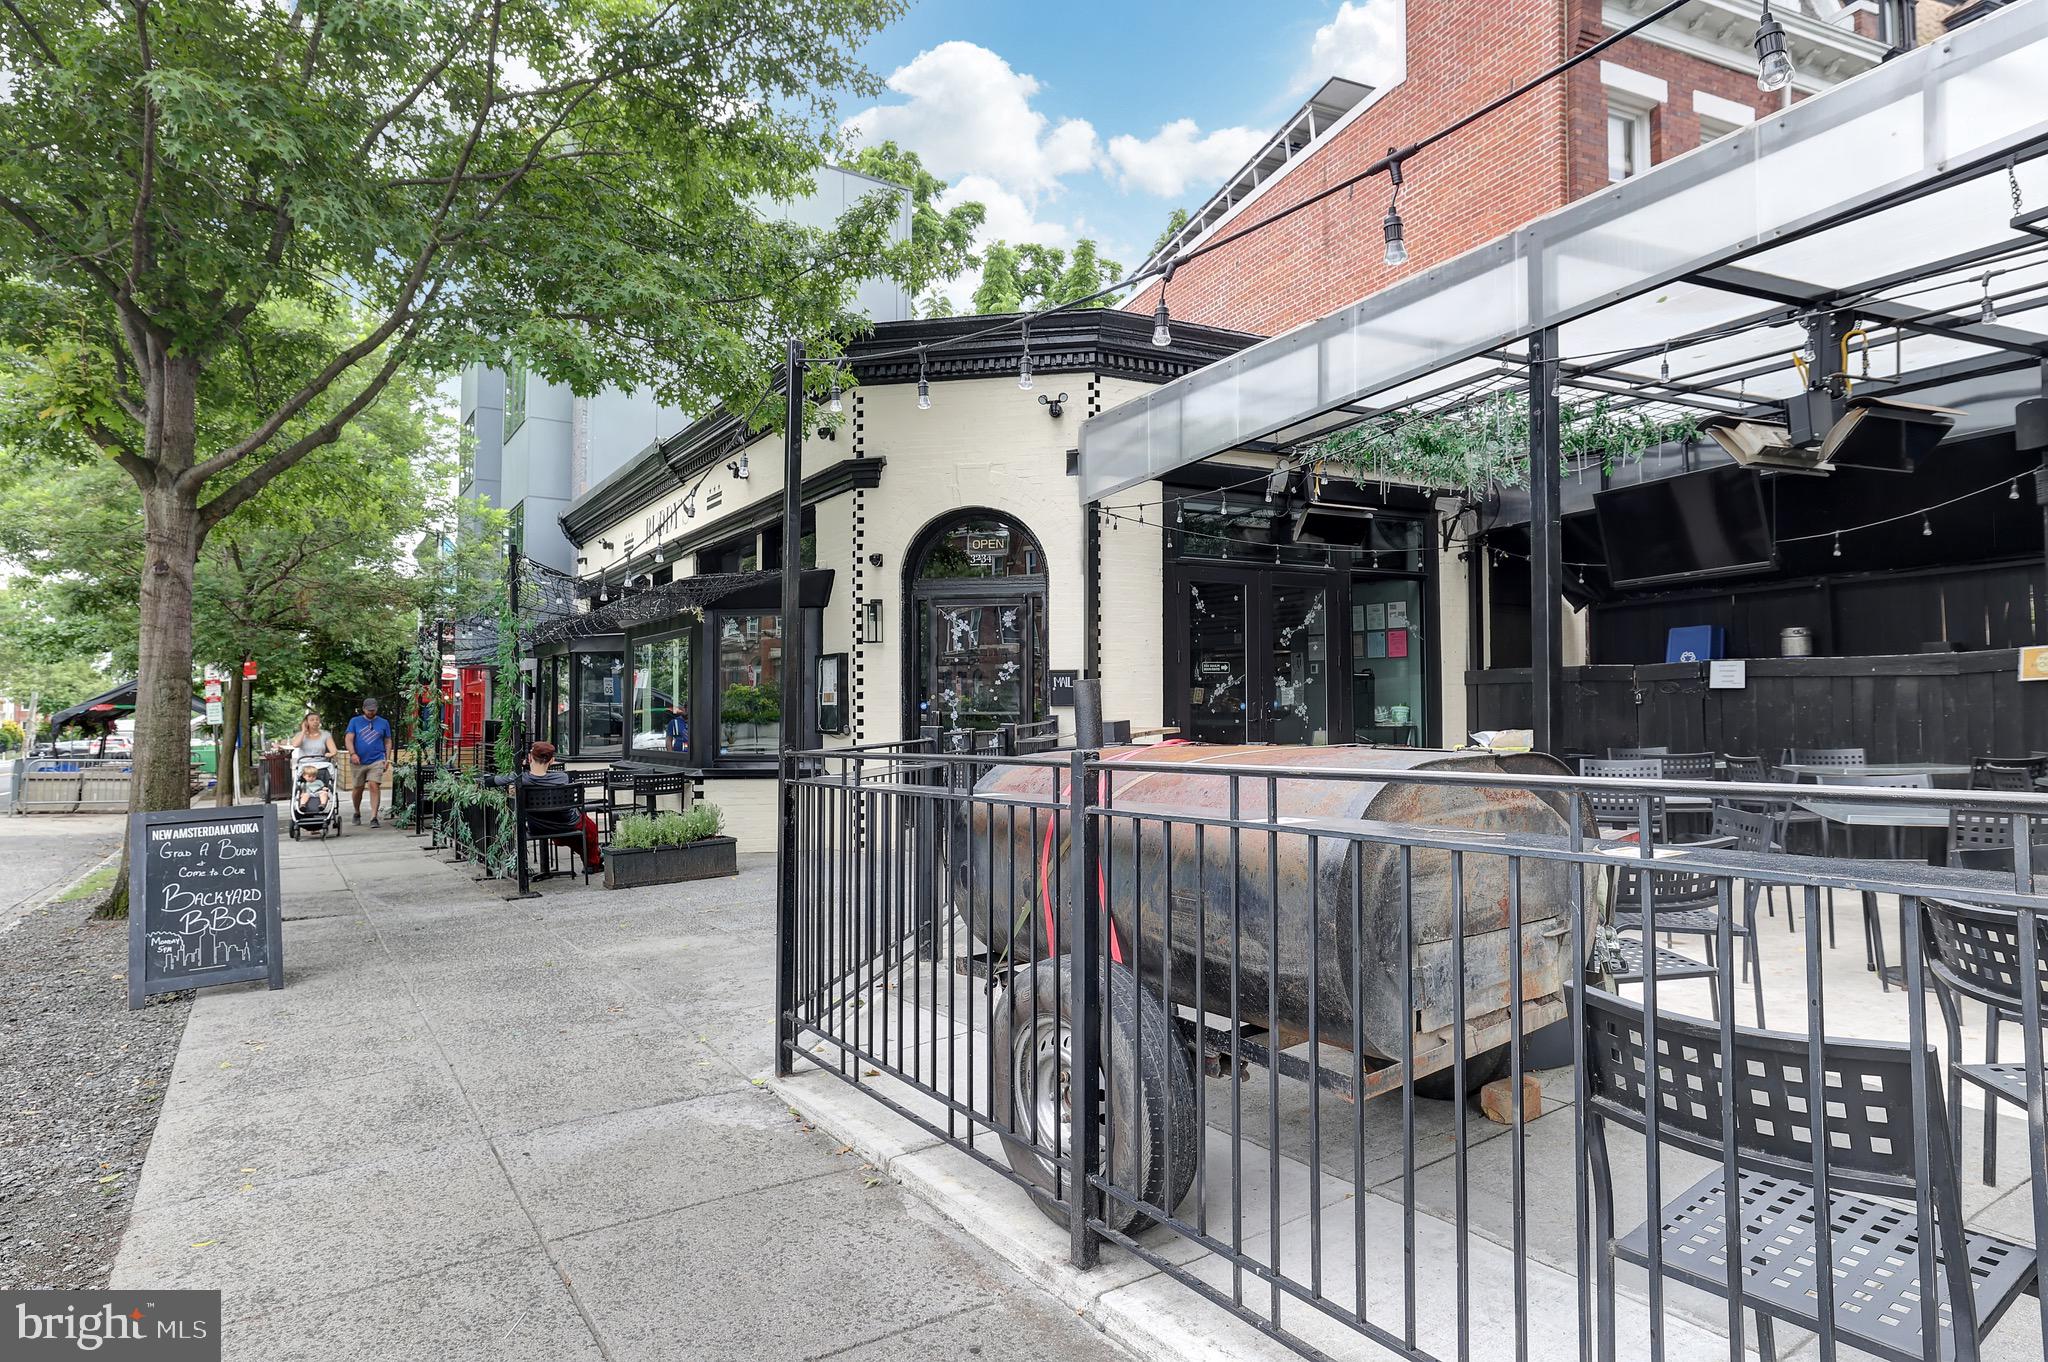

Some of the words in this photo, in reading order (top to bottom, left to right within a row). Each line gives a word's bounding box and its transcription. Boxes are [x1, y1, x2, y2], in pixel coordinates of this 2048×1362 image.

[972, 539, 1005, 550] OPEN
[1053, 676, 1074, 688] MAIL
[152, 829, 172, 841] NEW
[230, 822, 259, 835] VODKA
[160, 841, 192, 859] Grab
[199, 842, 210, 856] A
[209, 867, 219, 876] to
[161, 883, 262, 912] BACKYARD
[179, 906, 257, 935] BBQ
